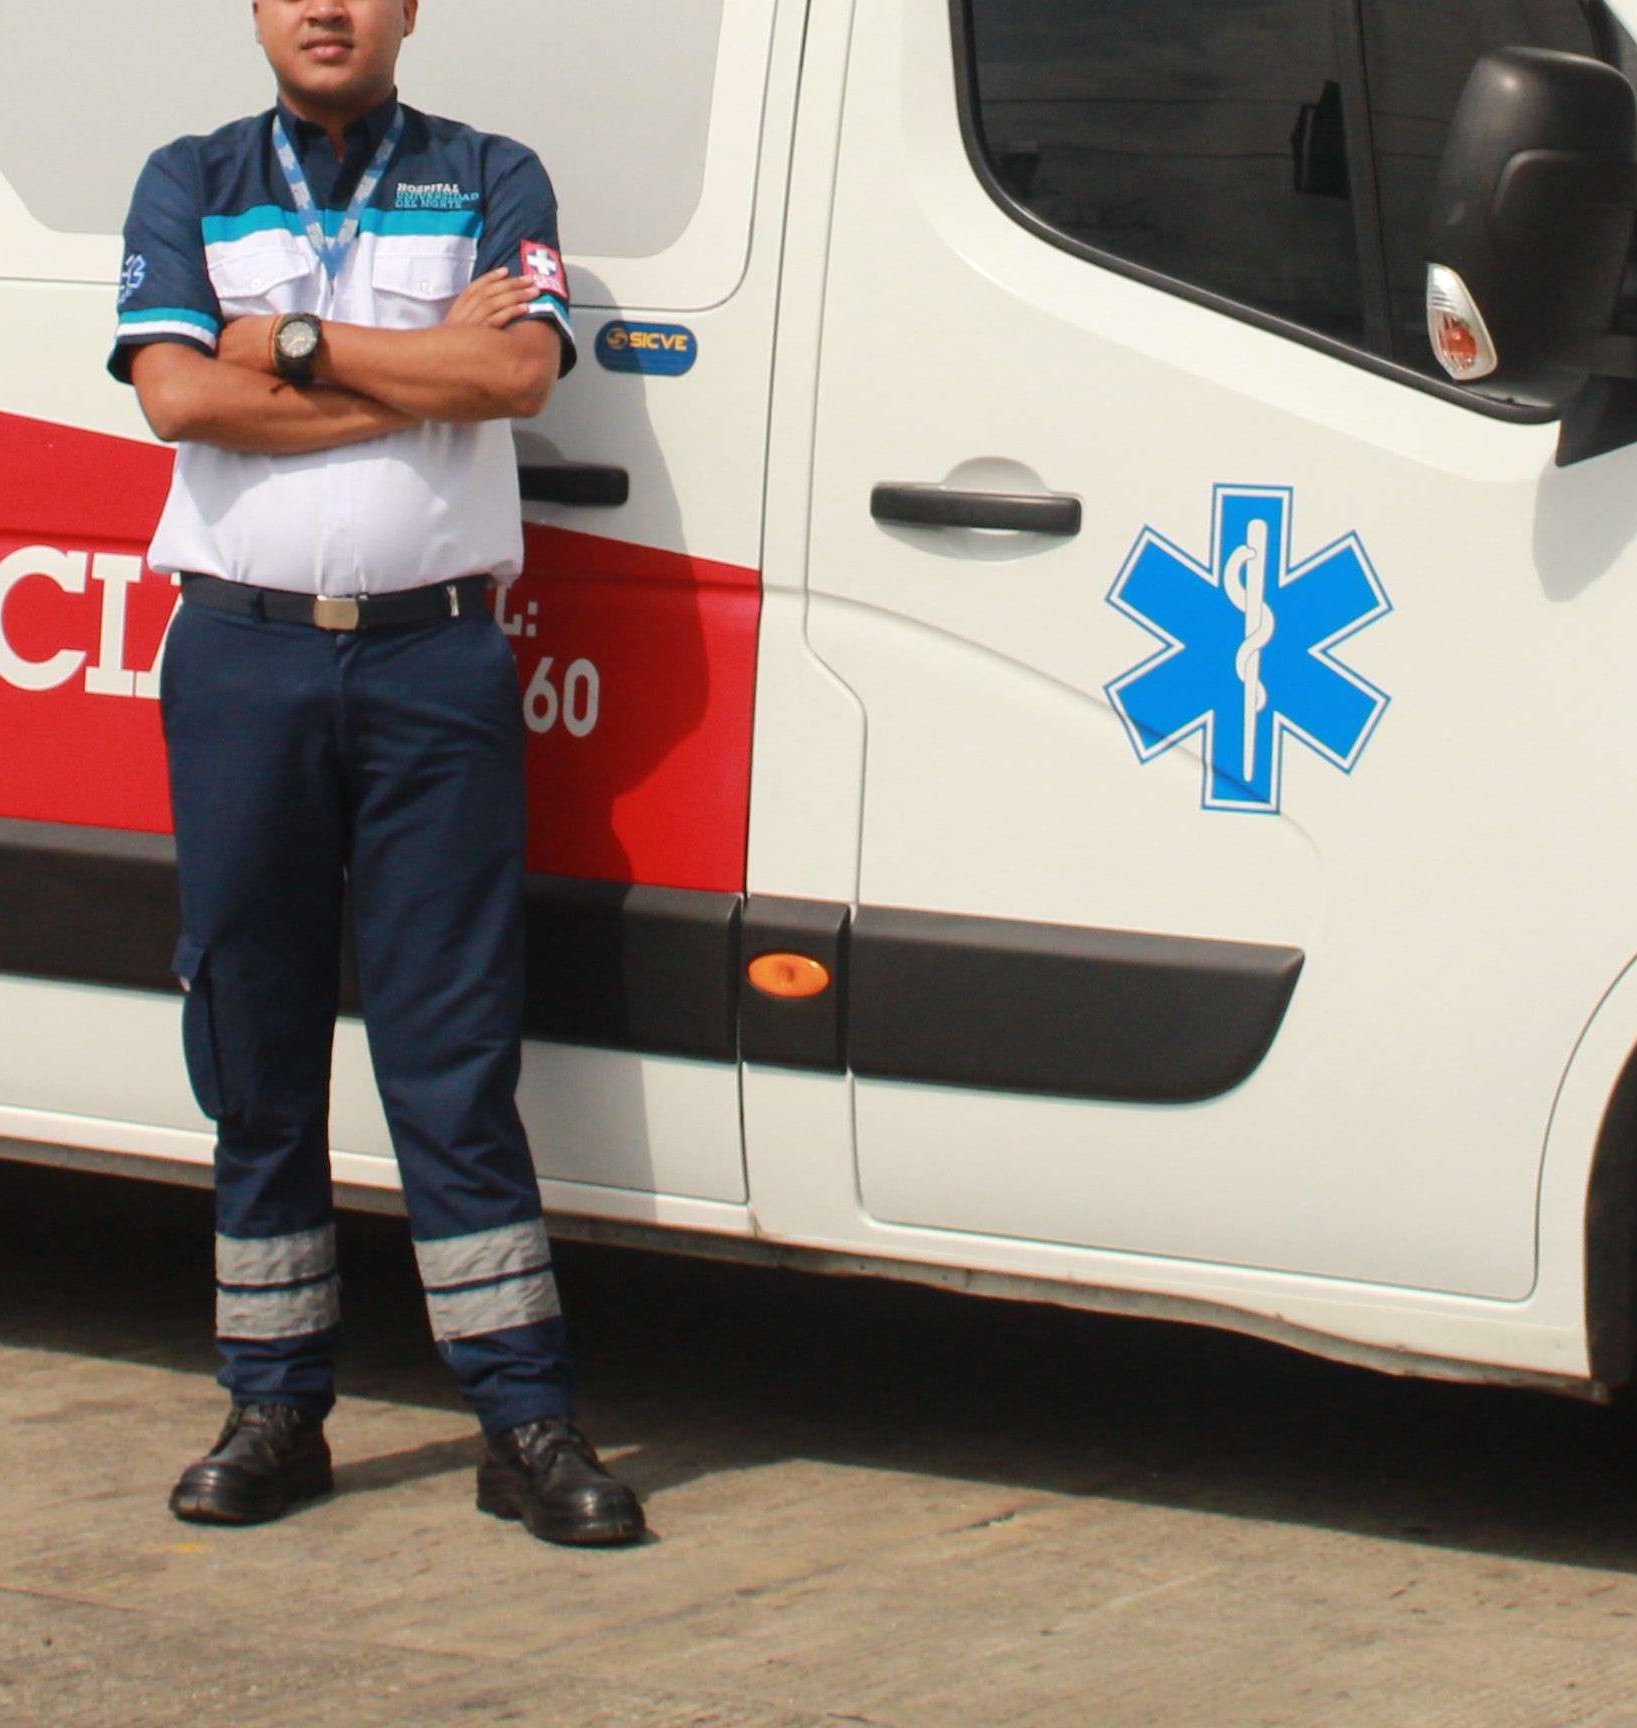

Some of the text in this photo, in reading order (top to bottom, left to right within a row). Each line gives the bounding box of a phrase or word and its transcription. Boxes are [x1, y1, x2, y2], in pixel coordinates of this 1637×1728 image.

[396, 182, 459, 193] HOSPITAL
[629, 331, 688, 351] SICVE
[513, 654, 600, 738] 60
